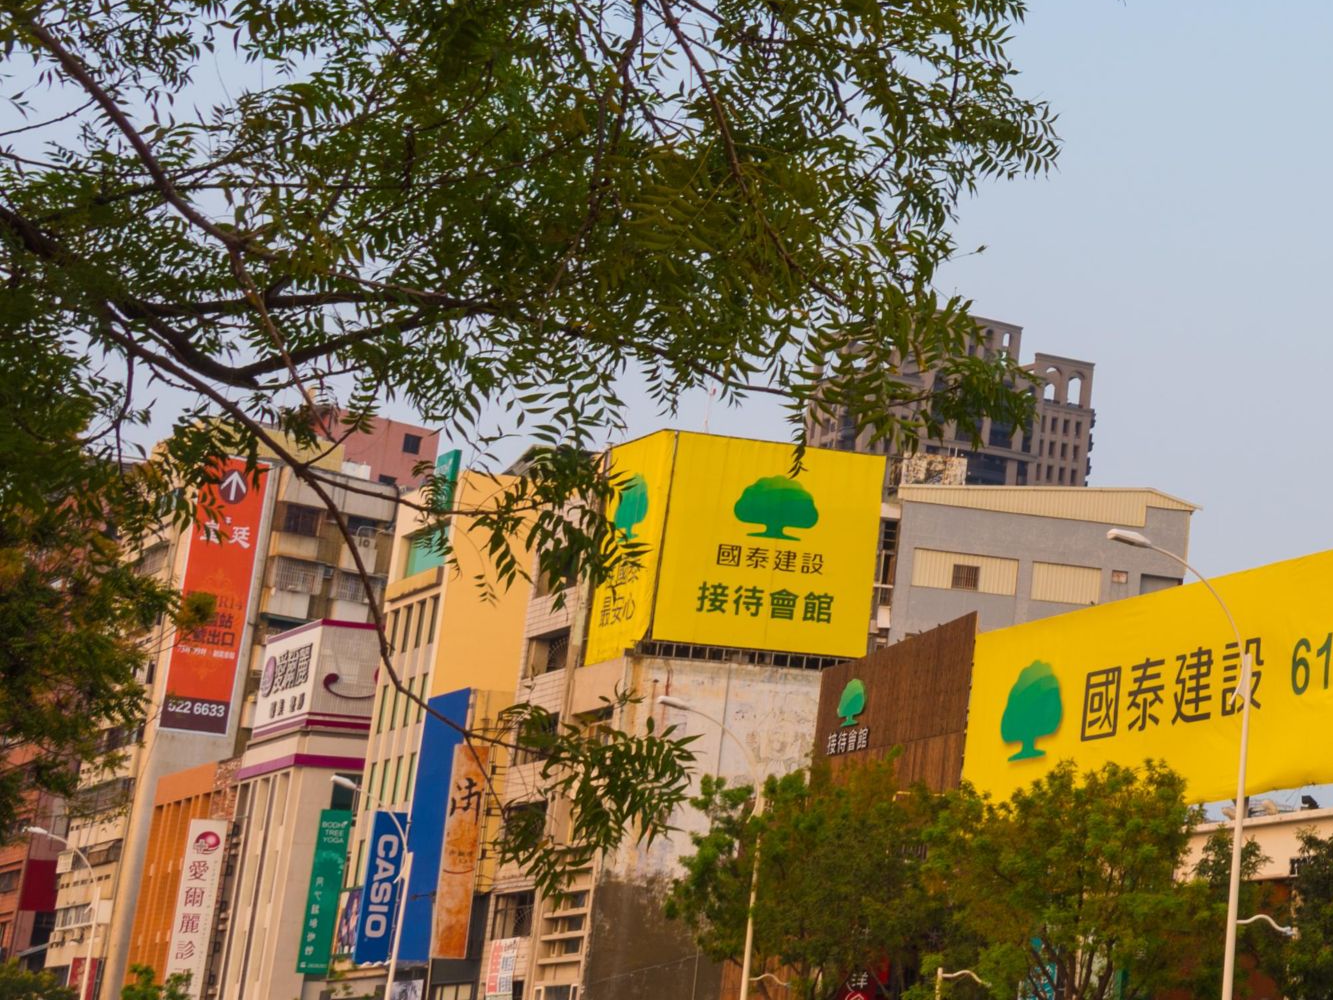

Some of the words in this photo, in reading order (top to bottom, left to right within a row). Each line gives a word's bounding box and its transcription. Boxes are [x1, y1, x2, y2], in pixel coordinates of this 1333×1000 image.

[716, 543, 824, 575] 國泰建設
[696, 581, 834, 624] 接待會館
[1080, 637, 1265, 742] 國泰建設
[193, 702, 226, 717] 6633
[827, 728, 869, 755] 接待會館
[323, 836, 344, 844] YOGA
[365, 834, 399, 939] CASIO
